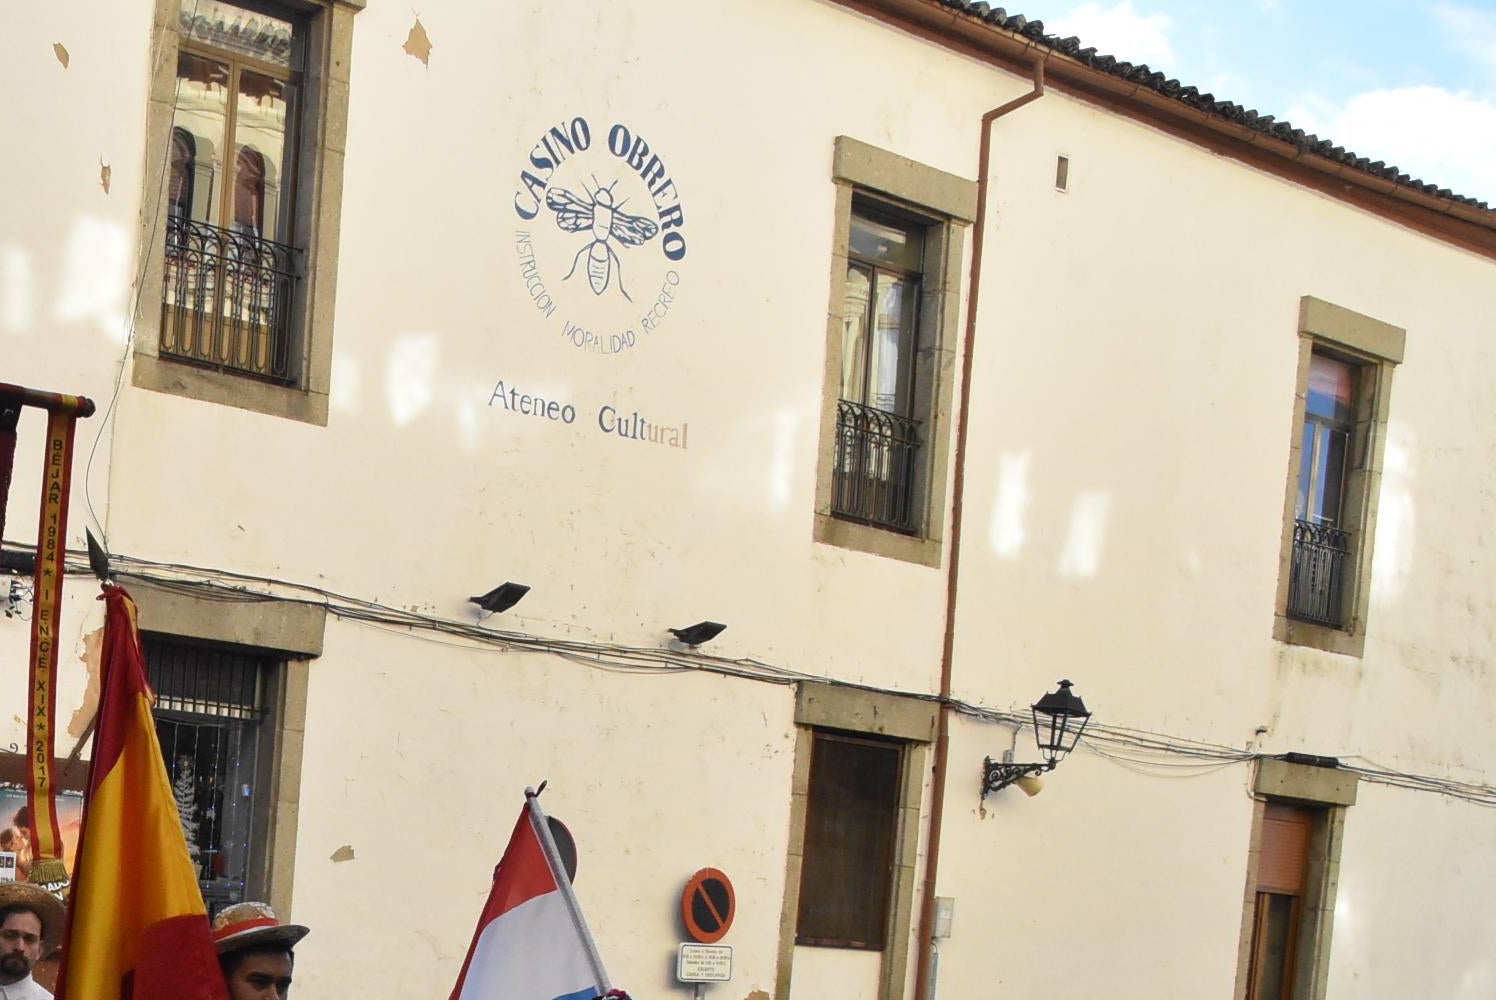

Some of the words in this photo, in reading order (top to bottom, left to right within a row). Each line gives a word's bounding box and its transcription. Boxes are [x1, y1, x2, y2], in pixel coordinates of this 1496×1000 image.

[514, 116, 592, 221] CASINO
[607, 123, 687, 262] OBRERO
[561, 320, 636, 355] MORALIDAD
[488, 379, 576, 424] Ateneo
[598, 405, 689, 450] Cultural
[45, 513, 57, 563] 1984
[35, 680, 46, 717] XIX
[35, 740, 46, 788] 2017
